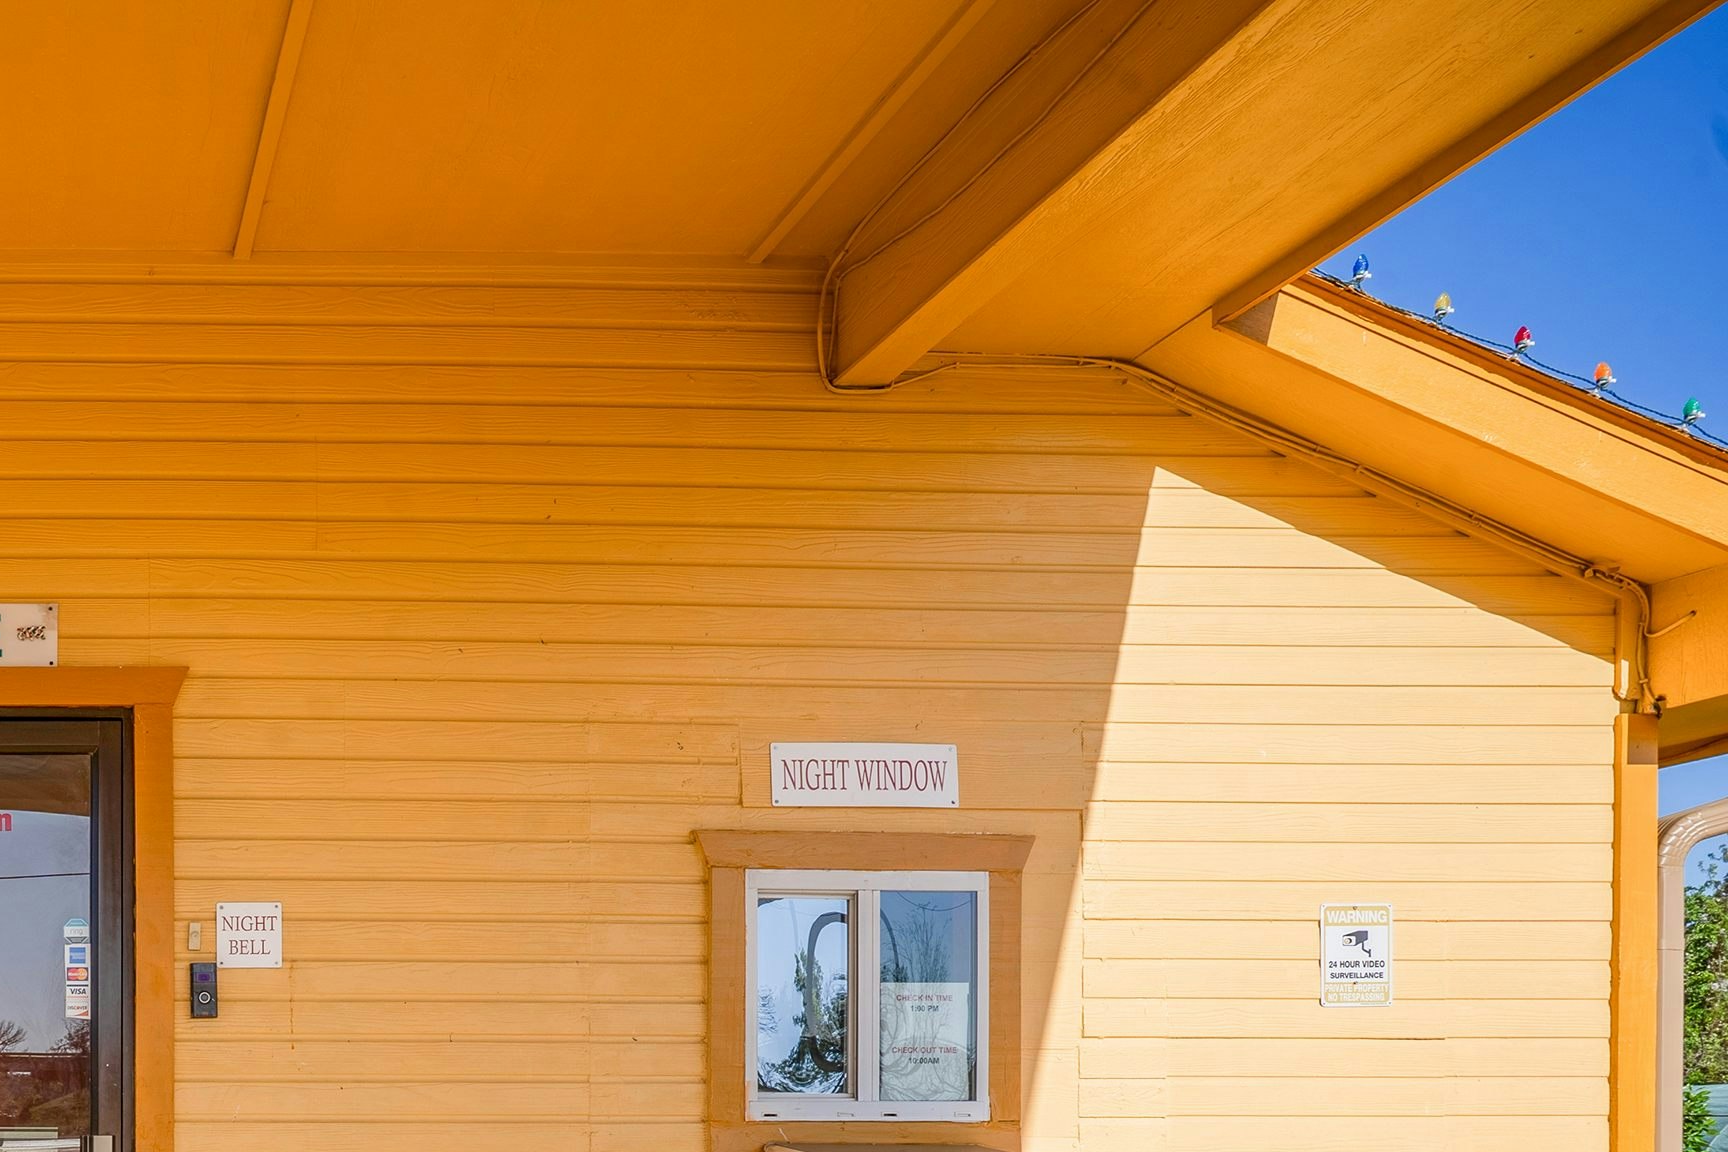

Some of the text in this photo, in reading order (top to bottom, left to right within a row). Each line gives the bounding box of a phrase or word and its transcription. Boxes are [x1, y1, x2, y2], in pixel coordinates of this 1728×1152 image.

[781, 758, 948, 792] NIGHT WINDOW
[1326, 910, 1387, 923] WARNING
[221, 916, 277, 932] NIGHT
[228, 939, 271, 955] BELL
[1328, 960, 1385, 969] 24 HOUR VIDEO
[892, 1046, 957, 1054] CHECK OUT TIME
